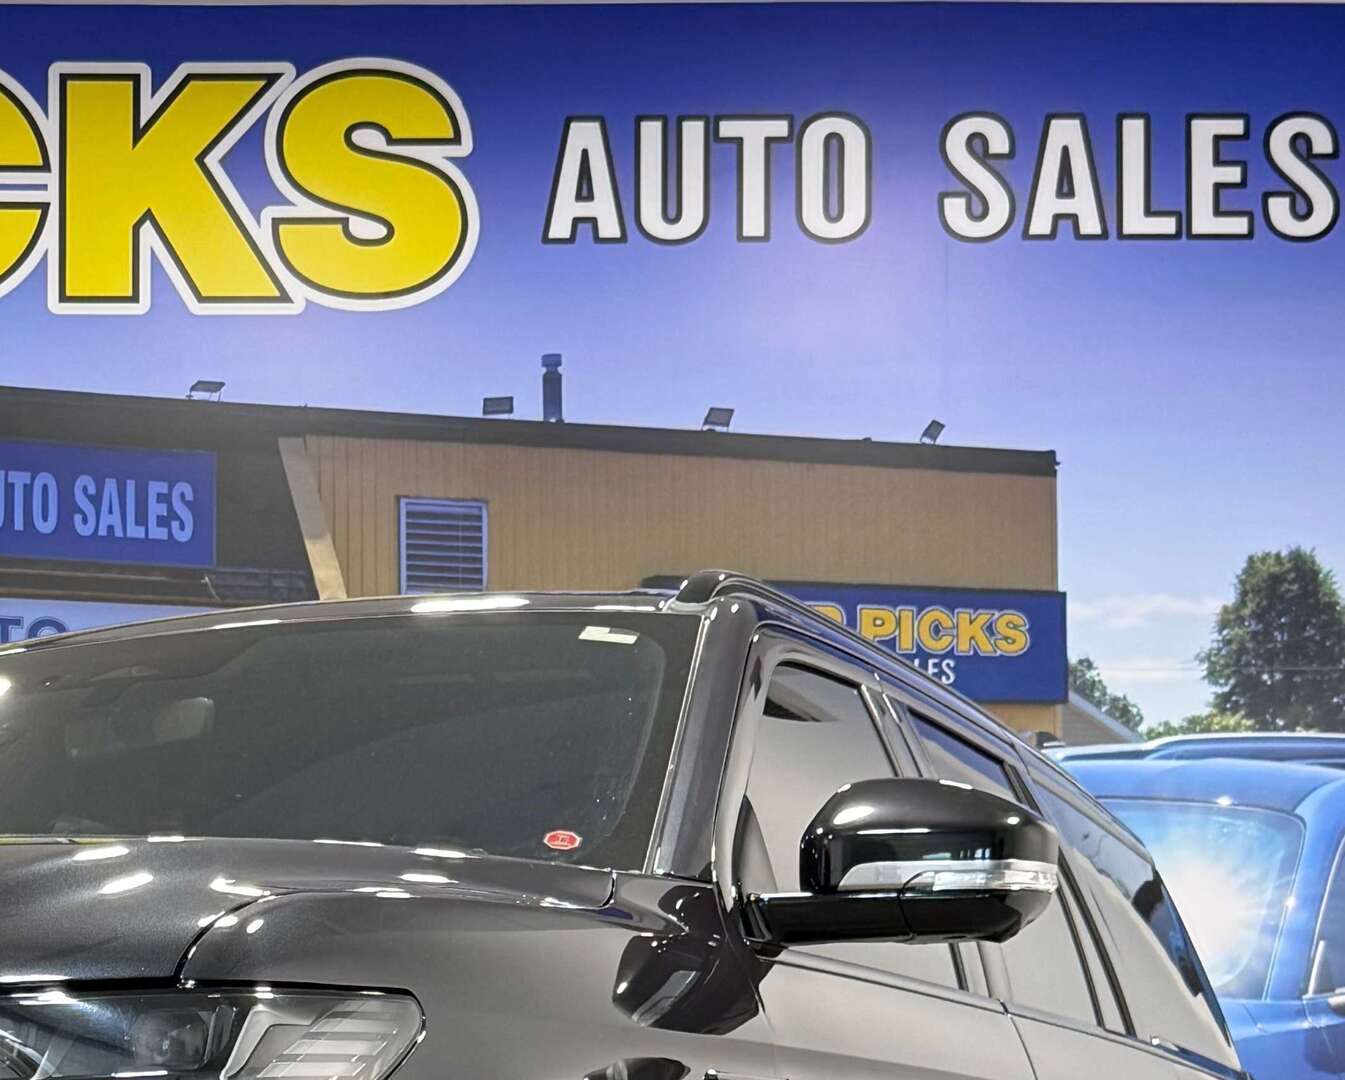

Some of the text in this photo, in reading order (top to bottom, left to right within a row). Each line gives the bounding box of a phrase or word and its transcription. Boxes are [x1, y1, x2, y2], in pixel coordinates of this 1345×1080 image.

[542, 112, 873, 244] AUTO
[941, 111, 1340, 241] SALES
[72, 474, 194, 543] SALES
[857, 604, 1030, 656] PICKS
